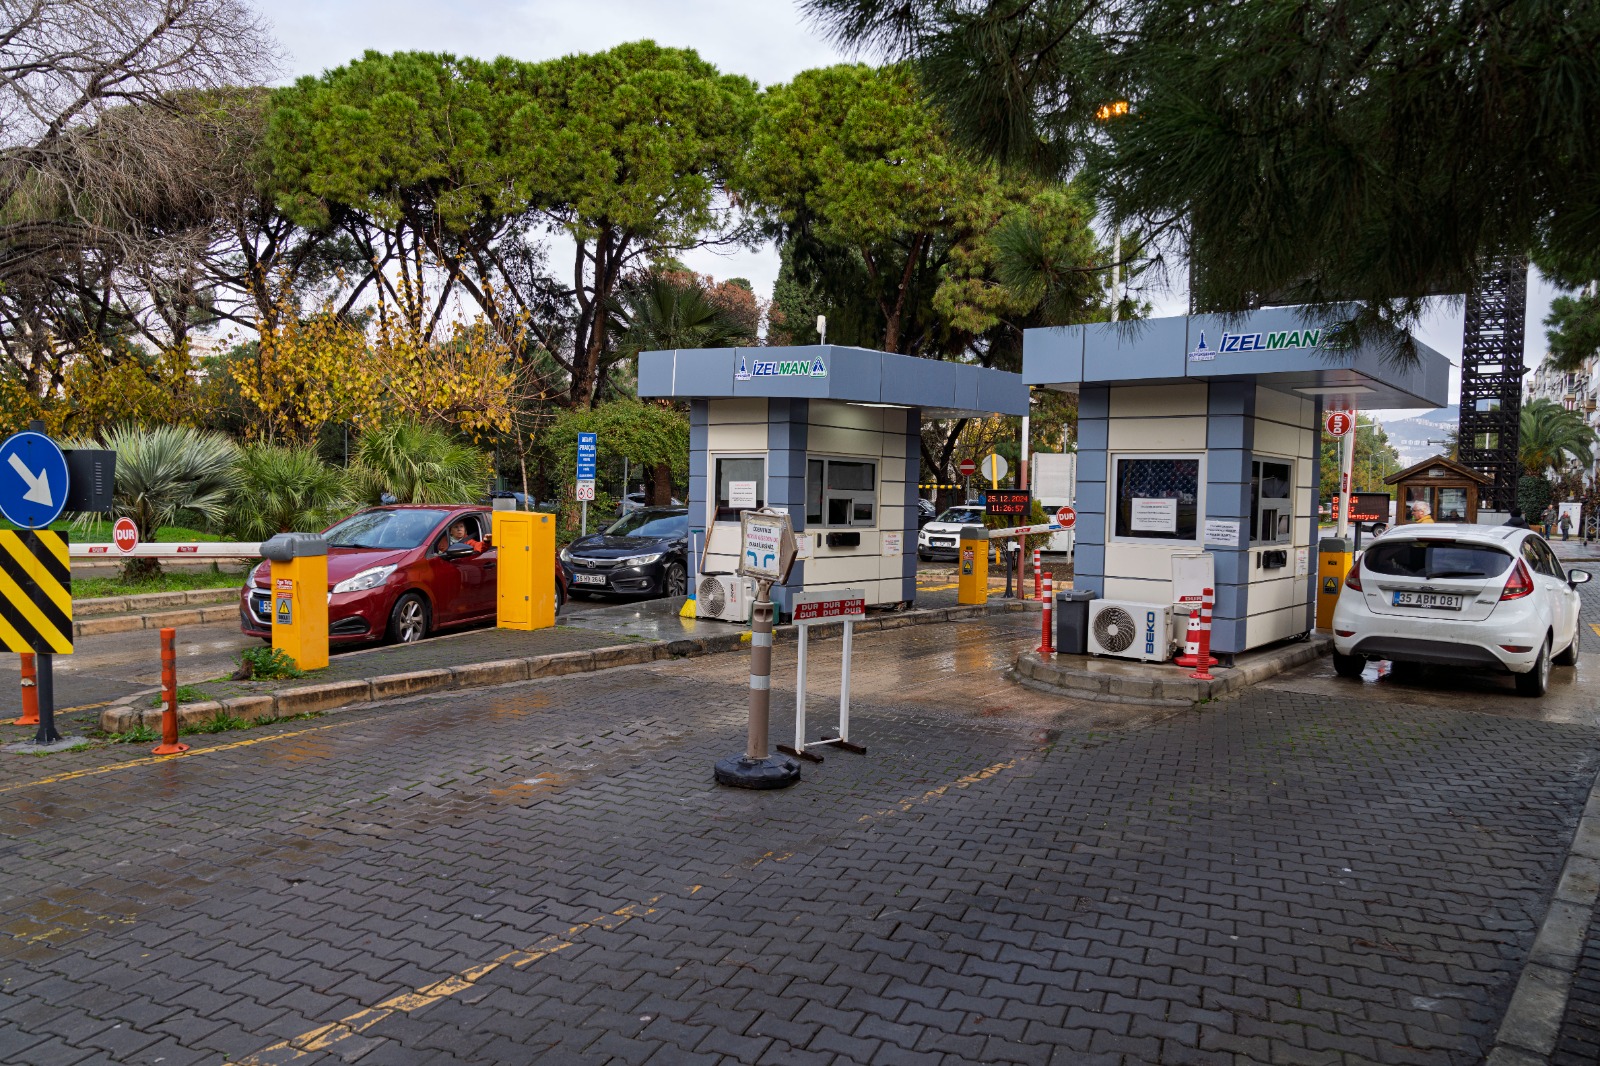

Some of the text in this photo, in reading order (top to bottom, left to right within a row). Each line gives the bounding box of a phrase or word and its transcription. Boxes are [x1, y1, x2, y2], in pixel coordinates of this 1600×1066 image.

[1219, 330, 1320, 353] İZELMAN
[752, 360, 810, 376] İZELMAN
[1333, 415, 1343, 433] DUR
[987, 495, 1028, 503] 25.12.2024
[1333, 512, 1379, 520] Bleniyor
[117, 529, 135, 540] DUR
[1400, 593, 1412, 603] 35
[1416, 594, 1437, 605] ABM
[1440, 595, 1459, 606] 081
[800, 610, 817, 618] DUR
[823, 608, 840, 616] DUR
[1146, 611, 1155, 654] BEKO
